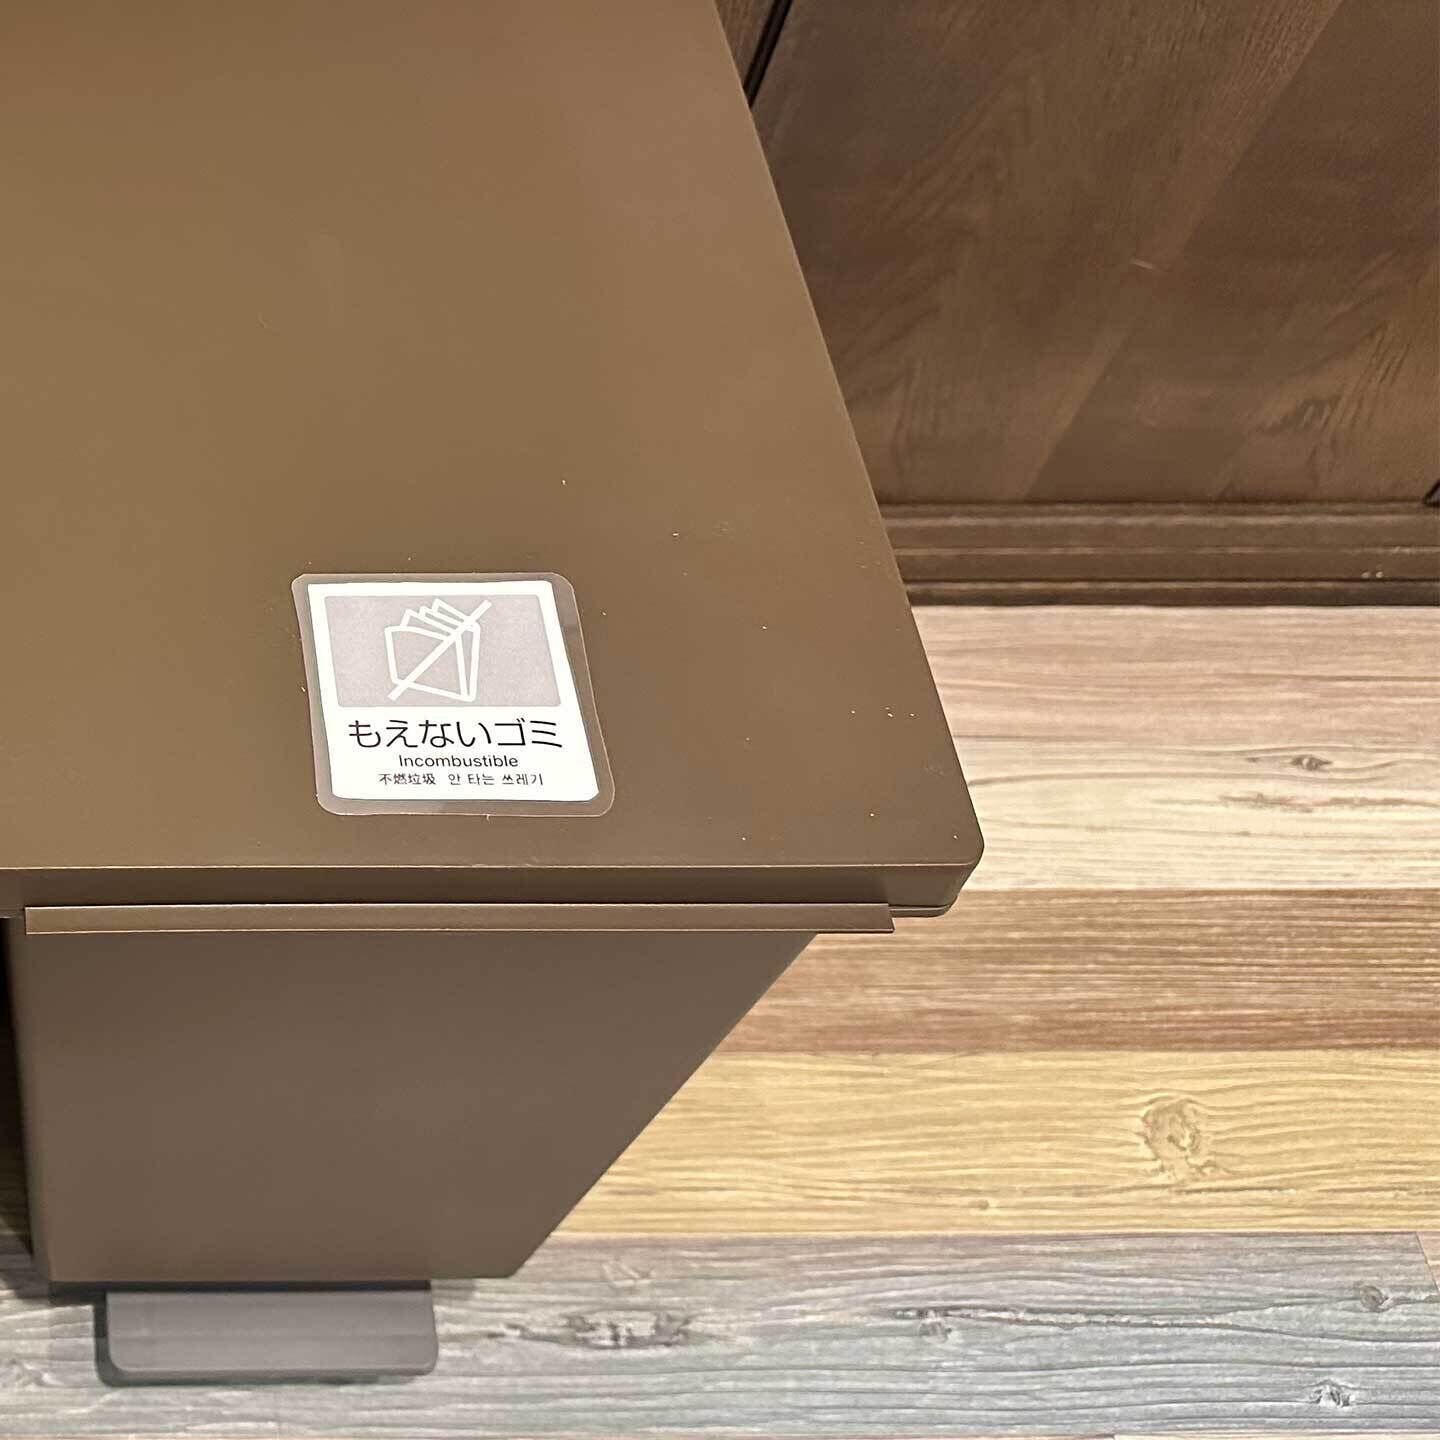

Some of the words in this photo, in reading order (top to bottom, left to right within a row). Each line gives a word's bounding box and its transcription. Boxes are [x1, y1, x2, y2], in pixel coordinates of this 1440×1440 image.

[348, 718, 563, 748] もえないゴミ
[399, 755, 519, 767] Incombustible
[378, 773, 436, 785] 不燃垃圾
[448, 773, 461, 785] 안
[468, 773, 495, 785] 타는
[502, 773, 544, 786] 쓰레기
